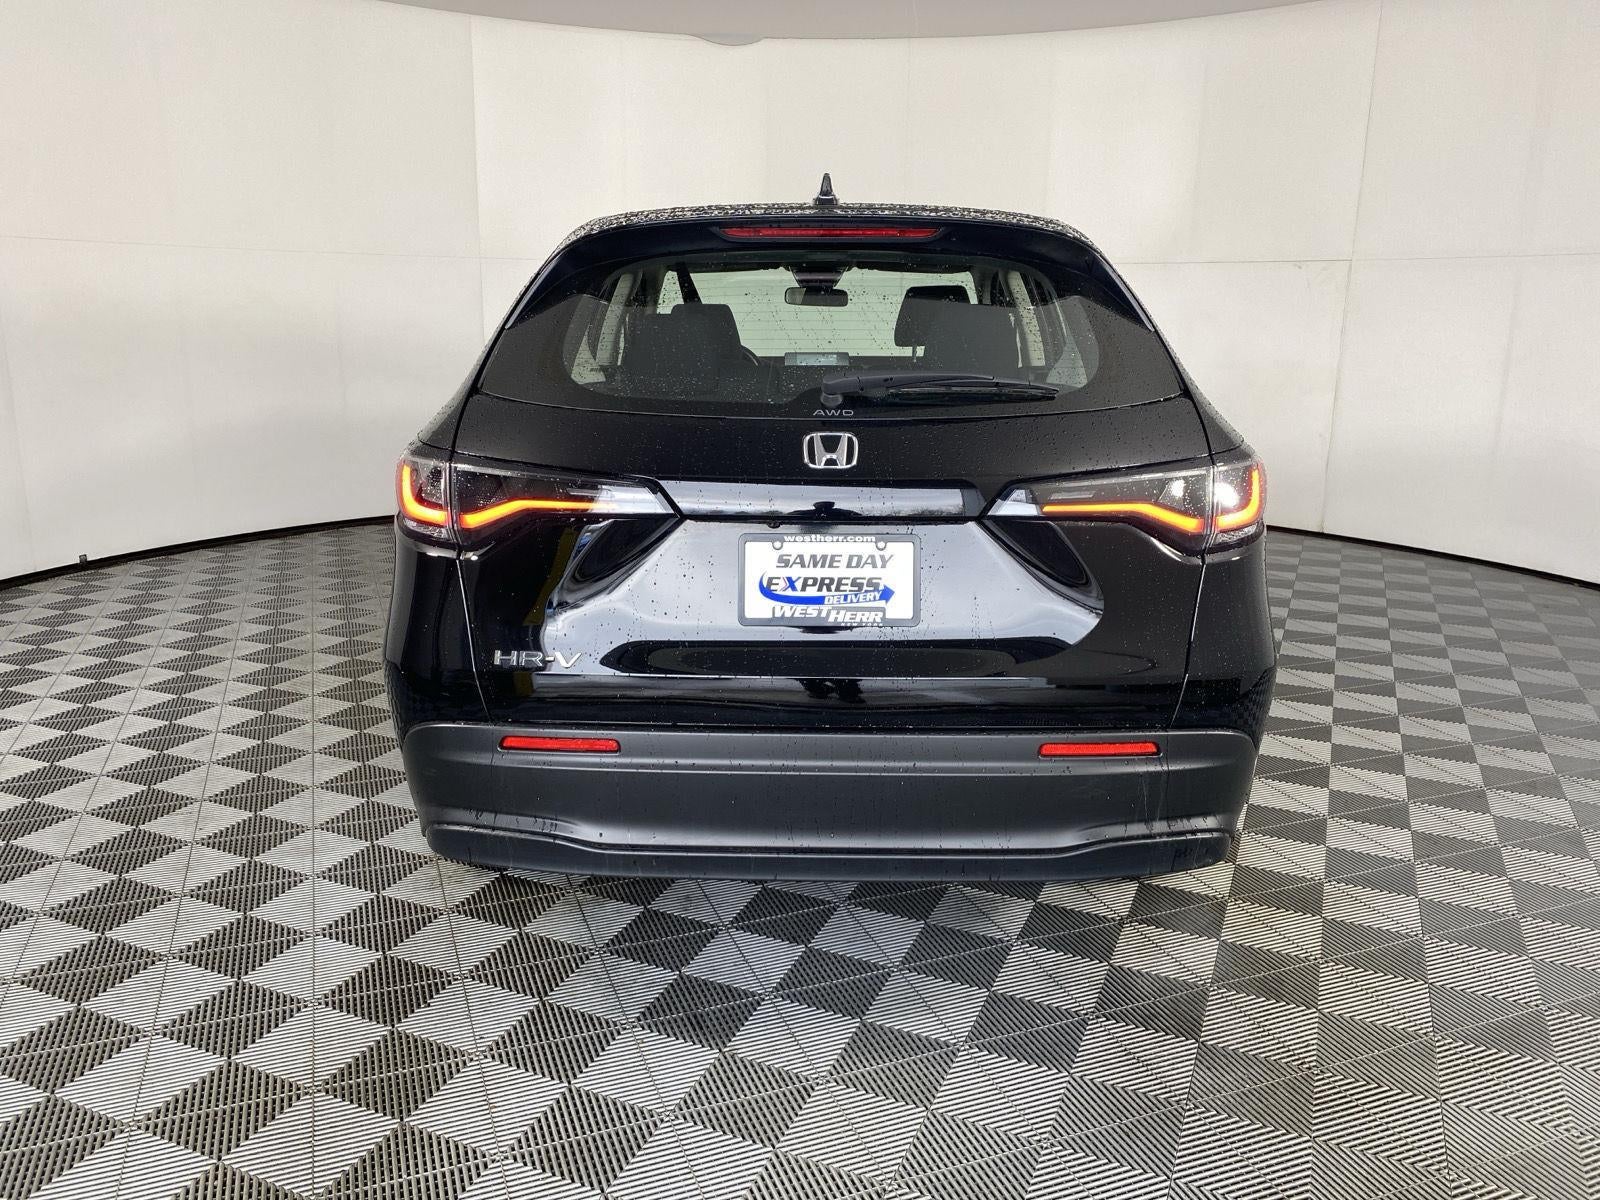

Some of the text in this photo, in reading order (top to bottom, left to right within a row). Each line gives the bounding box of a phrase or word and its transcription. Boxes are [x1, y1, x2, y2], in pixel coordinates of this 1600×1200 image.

[783, 534, 876, 543] westherr.com
[776, 553, 894, 569] SAME DAY
[765, 576, 883, 593] EXPRESS
[824, 591, 883, 605] DELIVERY
[493, 649, 582, 669] HR-V
